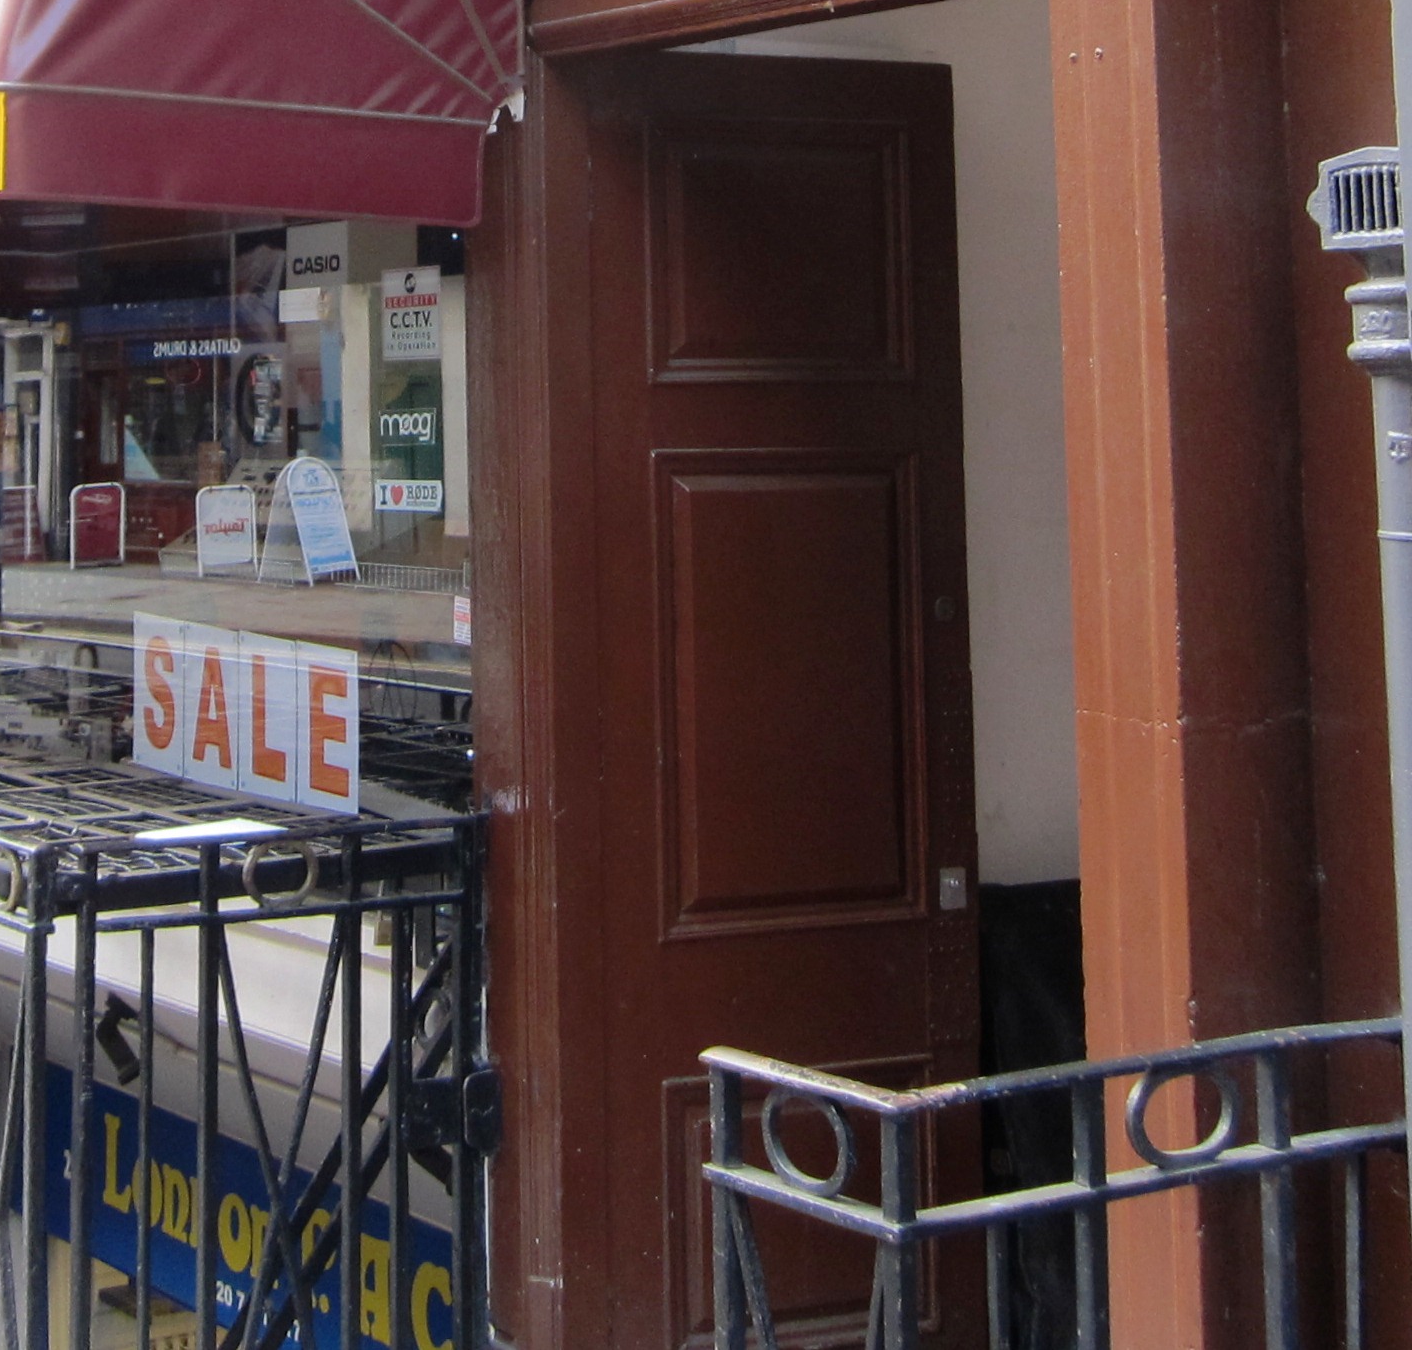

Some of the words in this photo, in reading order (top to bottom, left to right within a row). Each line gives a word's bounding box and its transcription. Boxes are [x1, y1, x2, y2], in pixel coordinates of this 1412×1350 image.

[293, 254, 340, 275] CASIO
[386, 294, 437, 308] SECURITY
[390, 311, 433, 329] C.C.T.V.
[380, 412, 431, 441] moog
[143, 635, 350, 798] SALE
